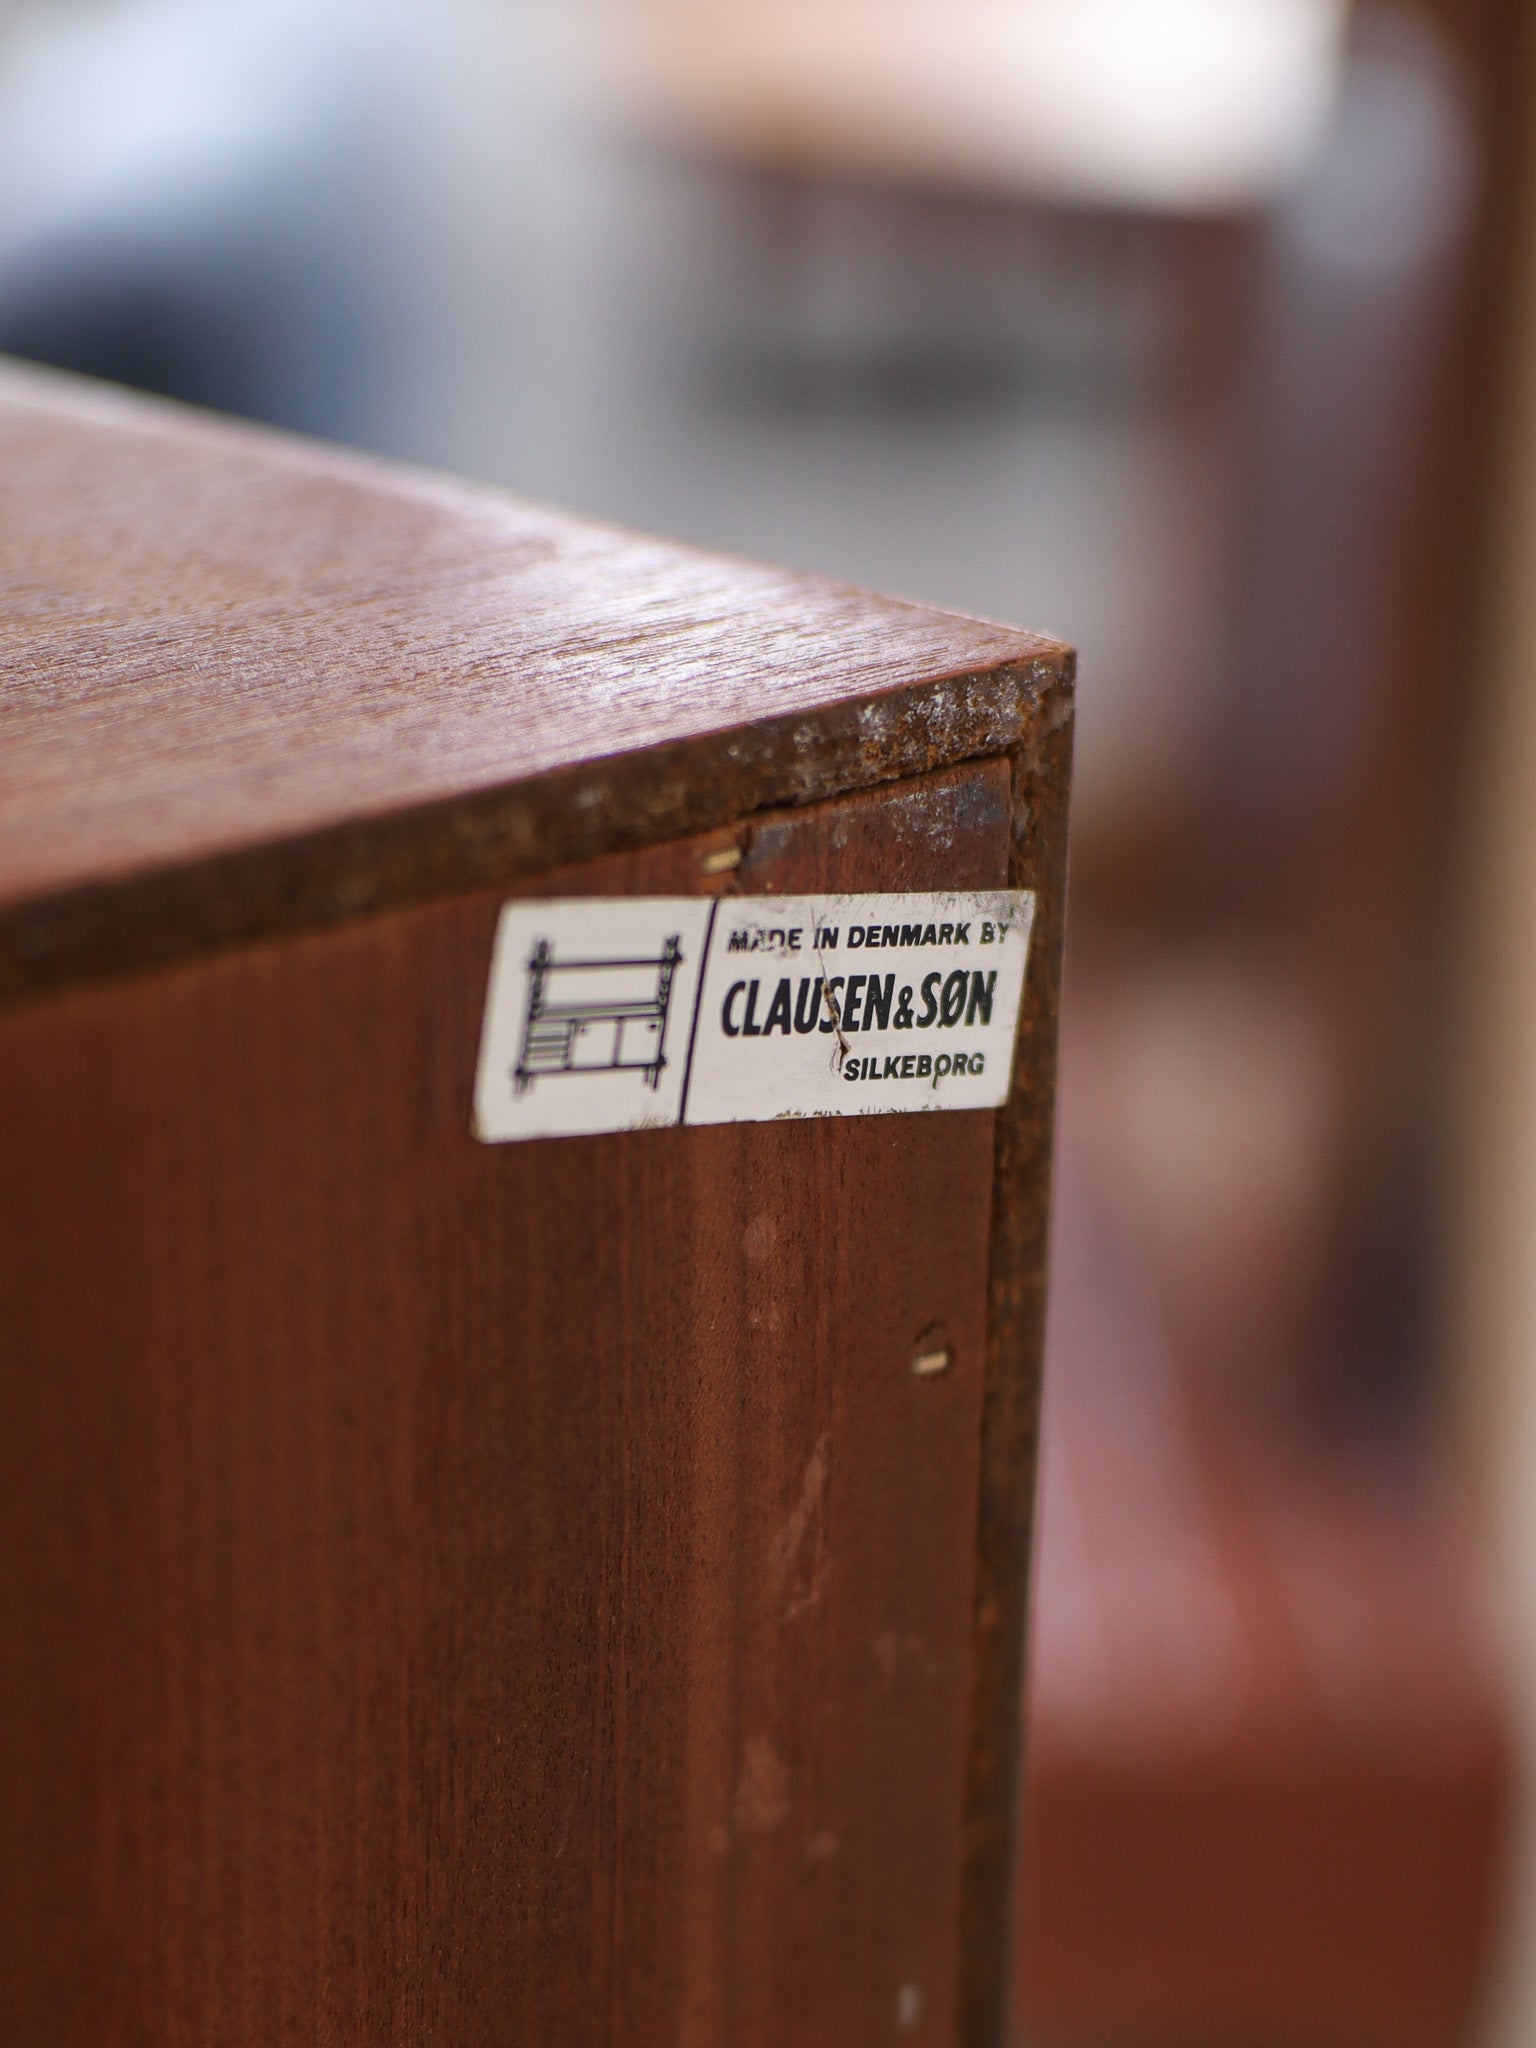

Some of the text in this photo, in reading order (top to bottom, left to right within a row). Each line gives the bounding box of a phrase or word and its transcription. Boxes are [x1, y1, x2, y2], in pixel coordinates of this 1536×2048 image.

[727, 921, 1010, 952] MADE IN DENMARK BY
[720, 969, 998, 1038] CLAUSEN&SØN
[843, 1052, 985, 1082] SILKEBORG
